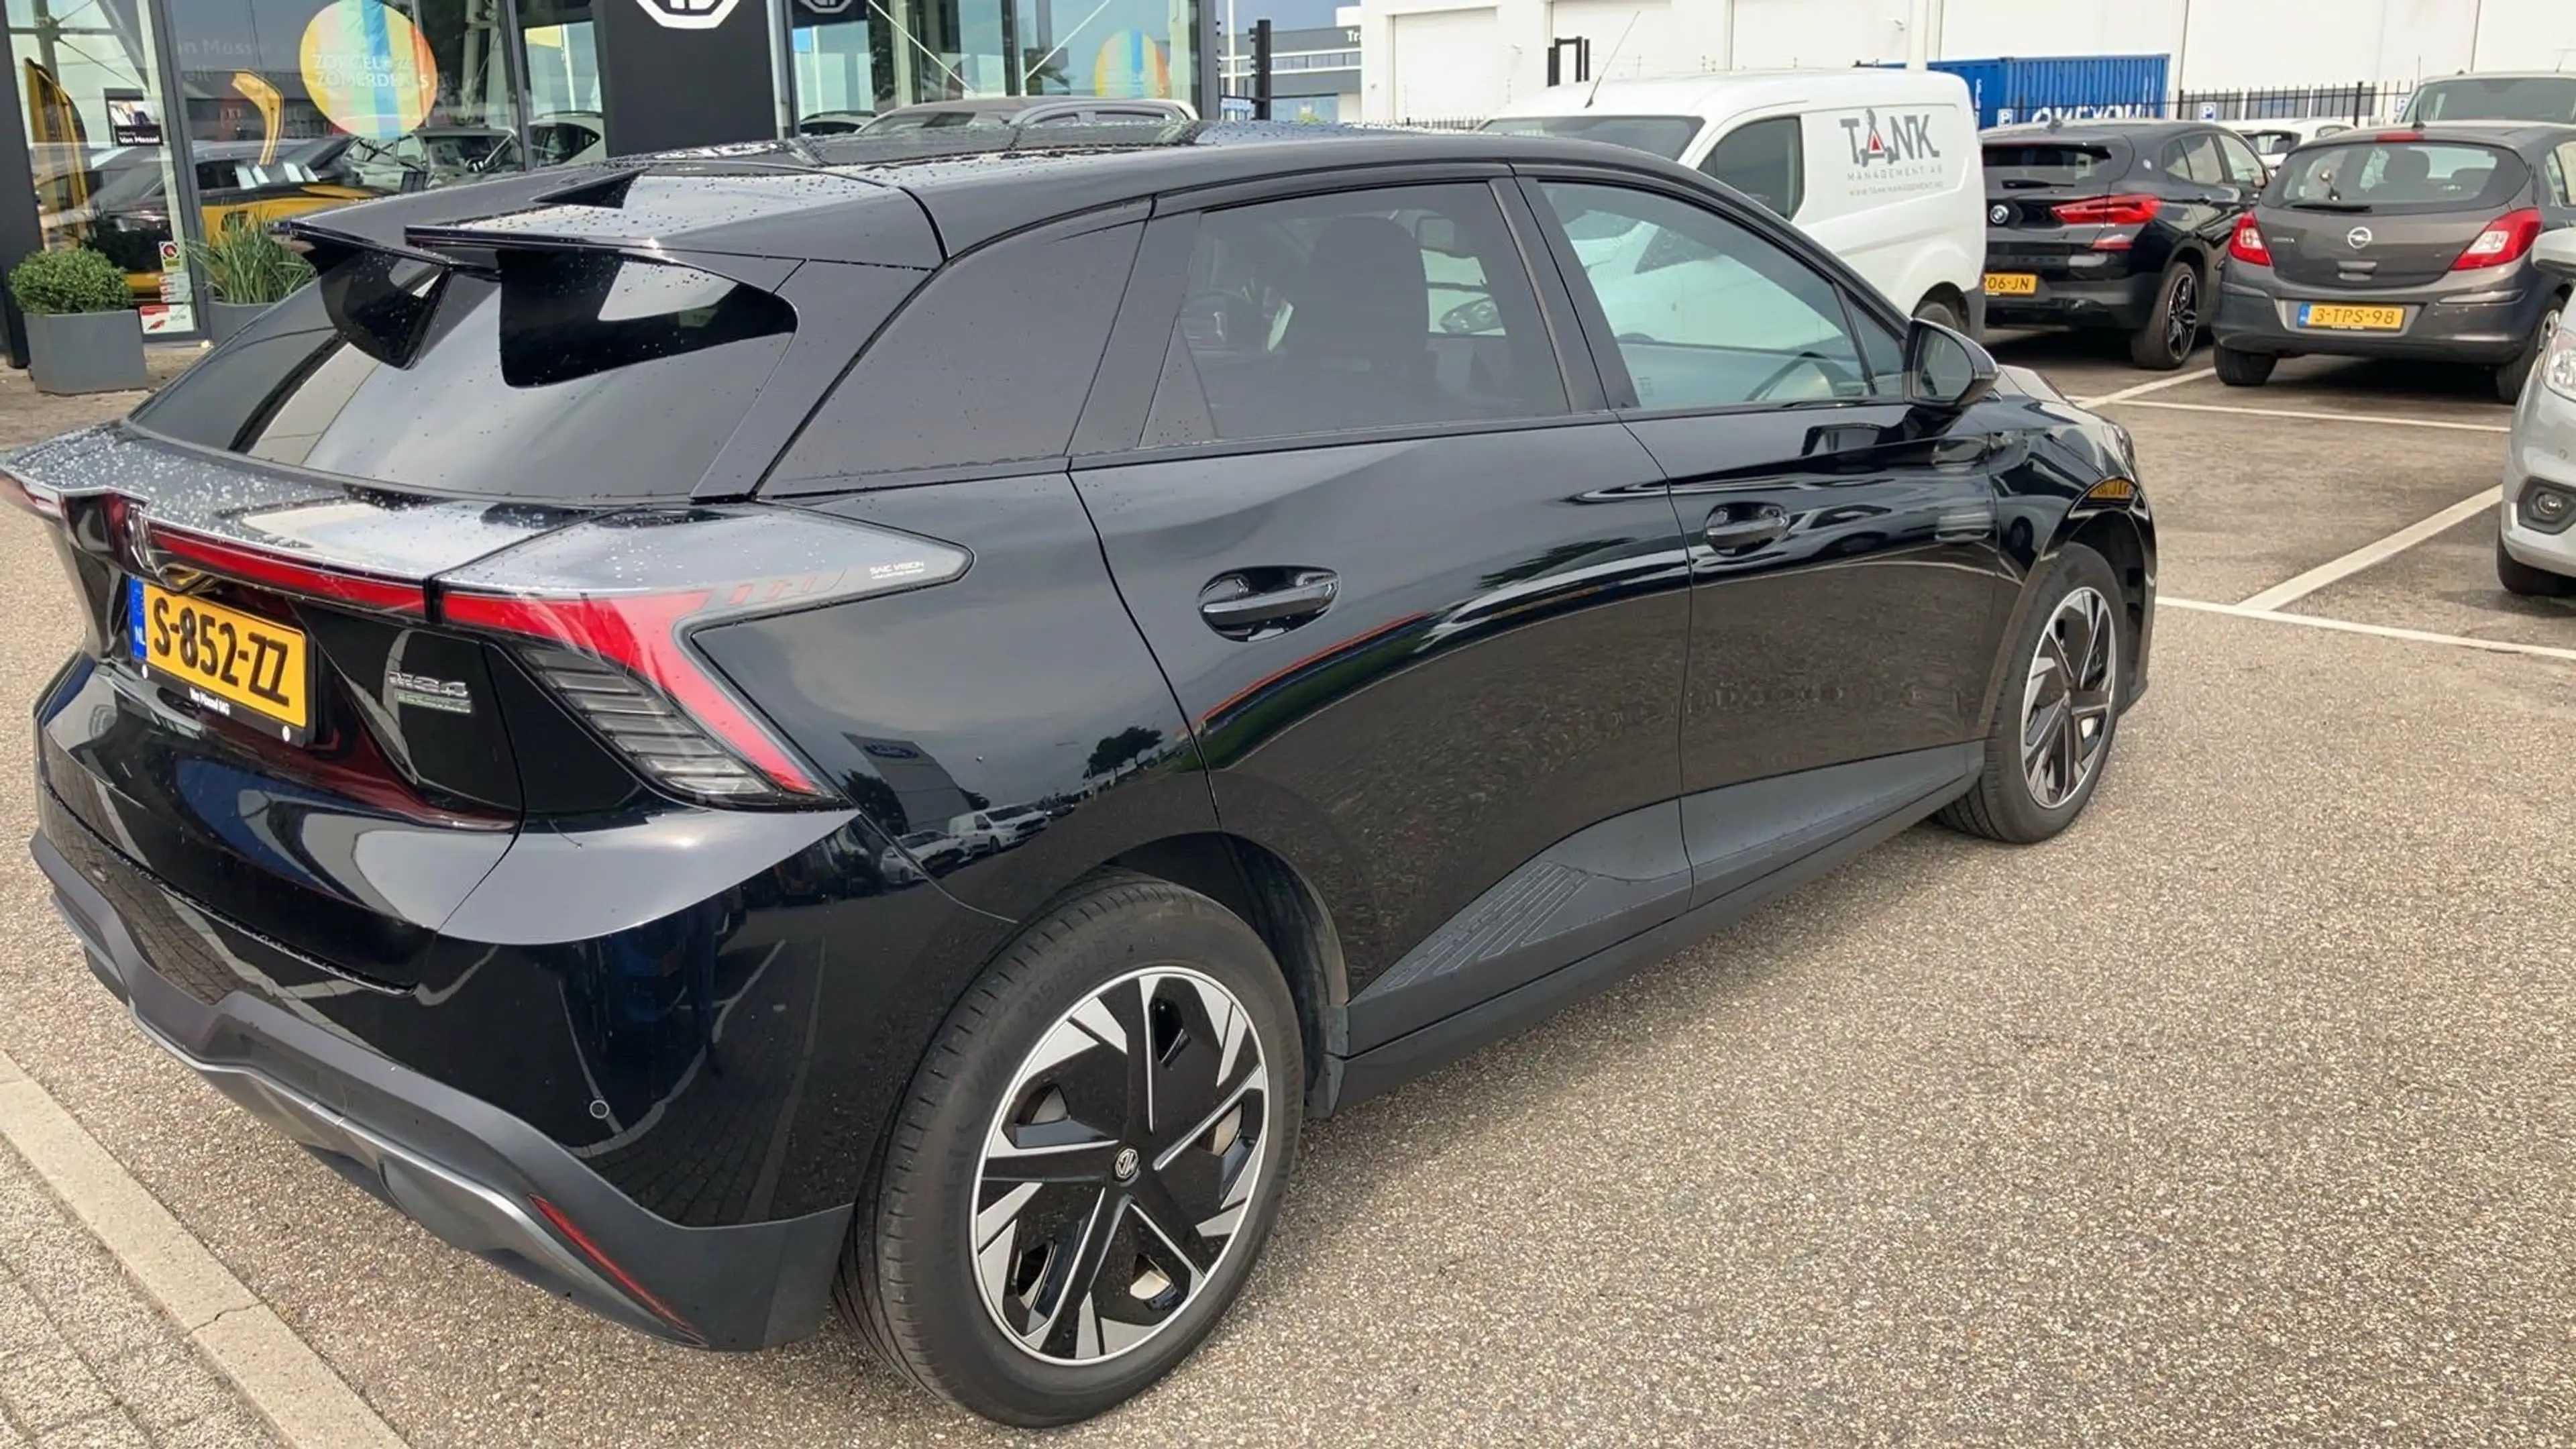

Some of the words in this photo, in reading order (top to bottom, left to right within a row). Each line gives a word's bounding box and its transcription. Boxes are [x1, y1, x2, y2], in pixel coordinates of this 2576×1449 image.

[1839, 108, 1941, 167] TANK
[1847, 166, 1925, 181] MANAGEMENT
[2315, 307, 2395, 324] 3-TPS-98
[154, 597, 290, 707] S-852-ZZ
